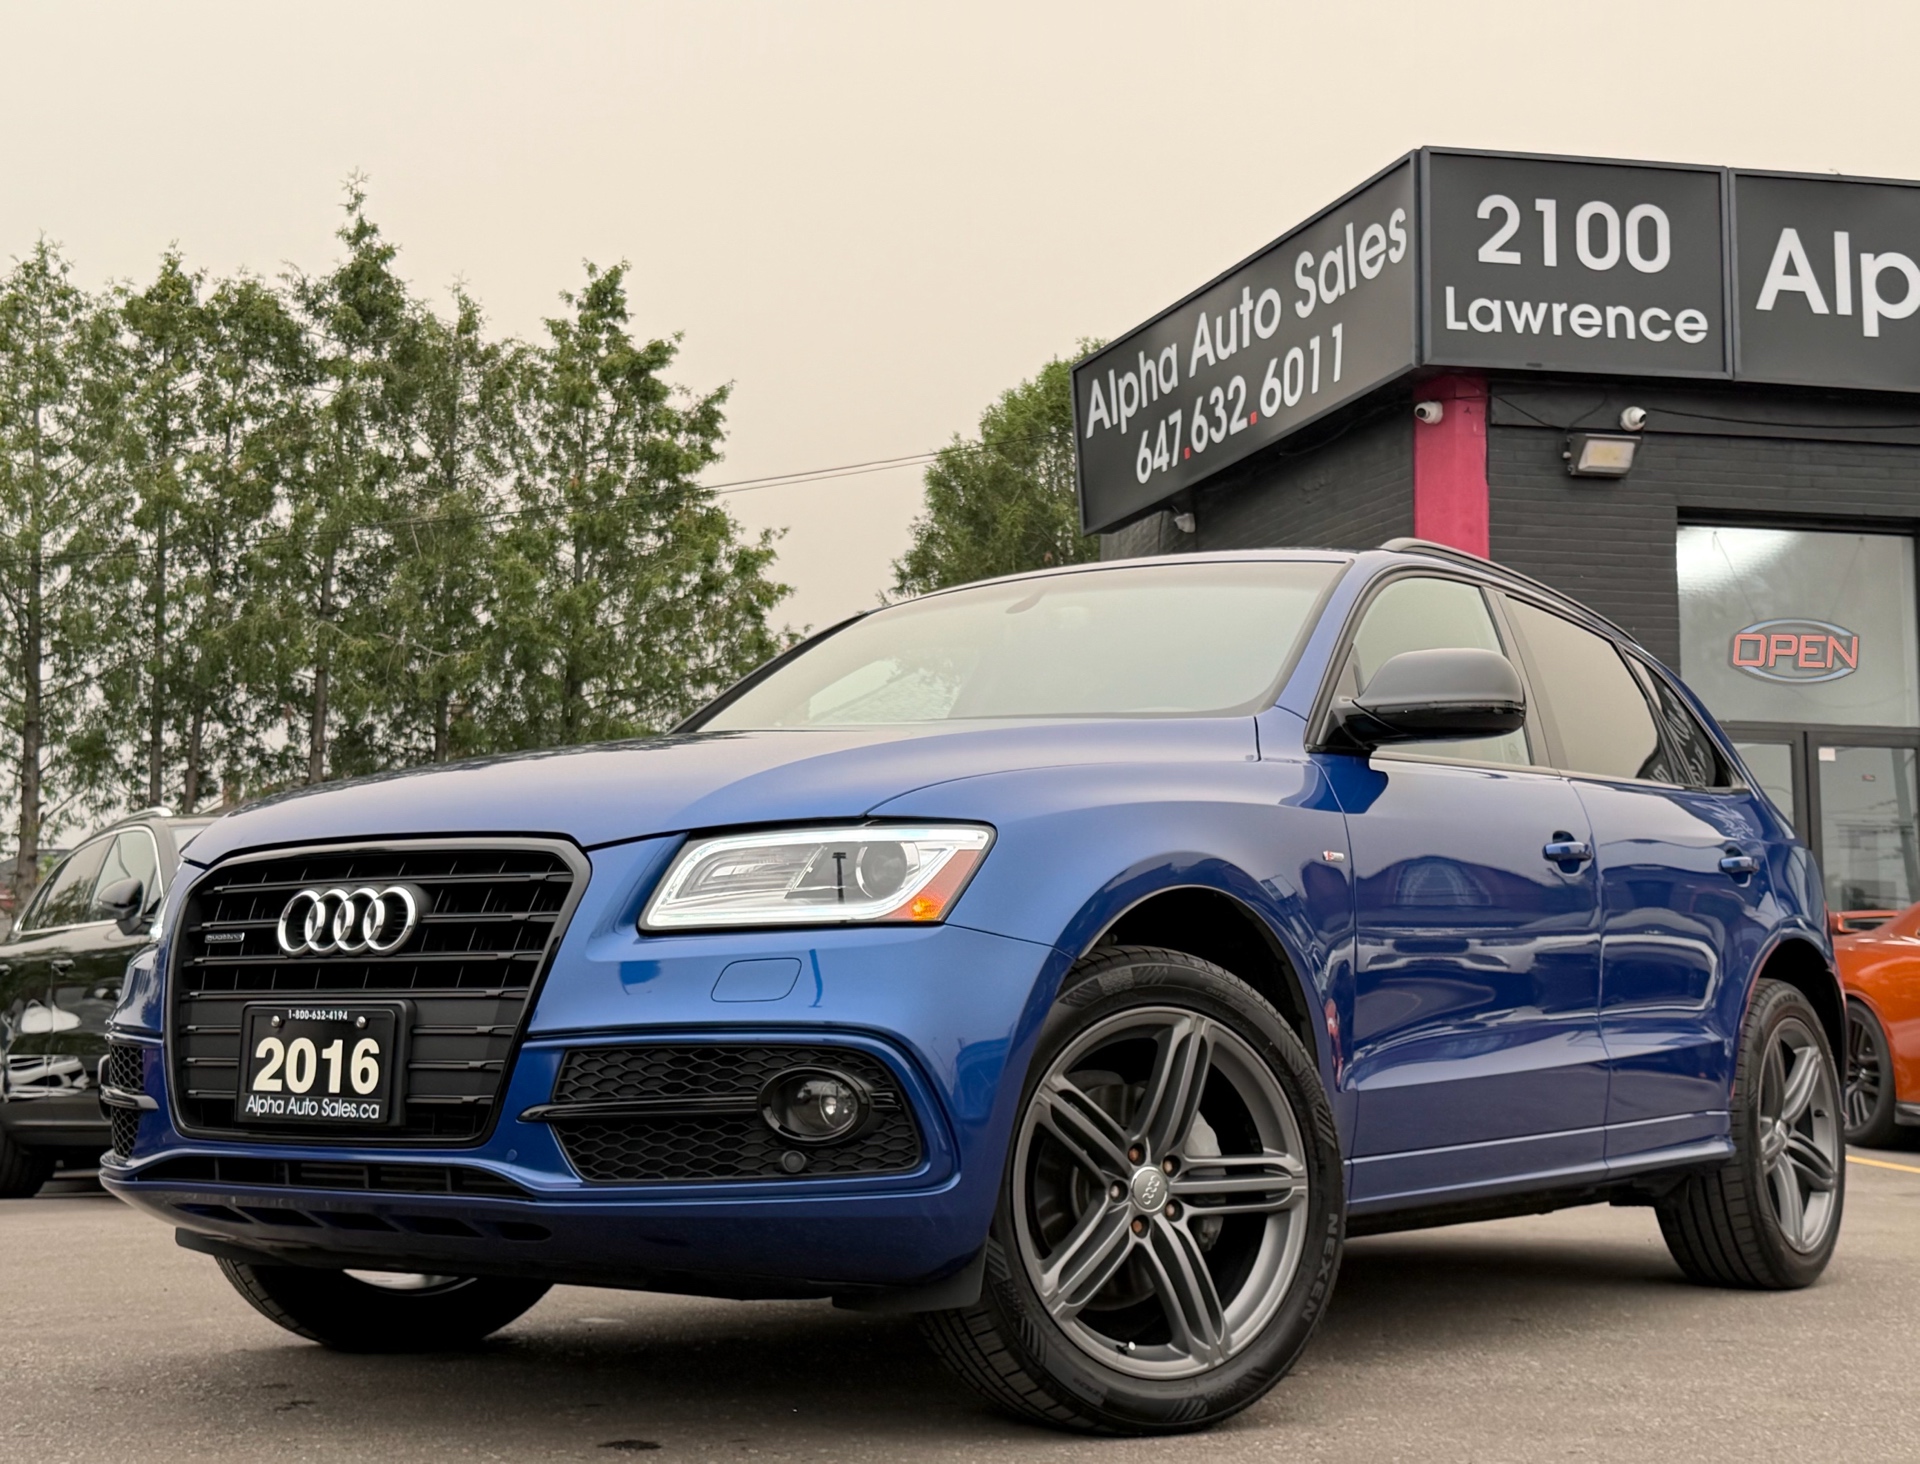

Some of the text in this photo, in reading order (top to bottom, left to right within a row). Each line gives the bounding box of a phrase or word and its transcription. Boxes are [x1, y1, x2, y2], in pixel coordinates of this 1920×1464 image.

[1476, 193, 1671, 274] 2100
[1445, 285, 1709, 344] Lawrence
[1755, 227, 1920, 338] Alp
[1085, 207, 1407, 439] Alpha Auto Sales
[1135, 322, 1343, 485] 647.632.6011
[1732, 633, 1860, 670] OPEN
[288, 1009, 348, 1021] 1-800-632-4194
[252, 1036, 380, 1095] 2016
[245, 1094, 380, 1119] Alpha Auto Sales.ca
[1301, 1213, 1339, 1322] NEXEN
